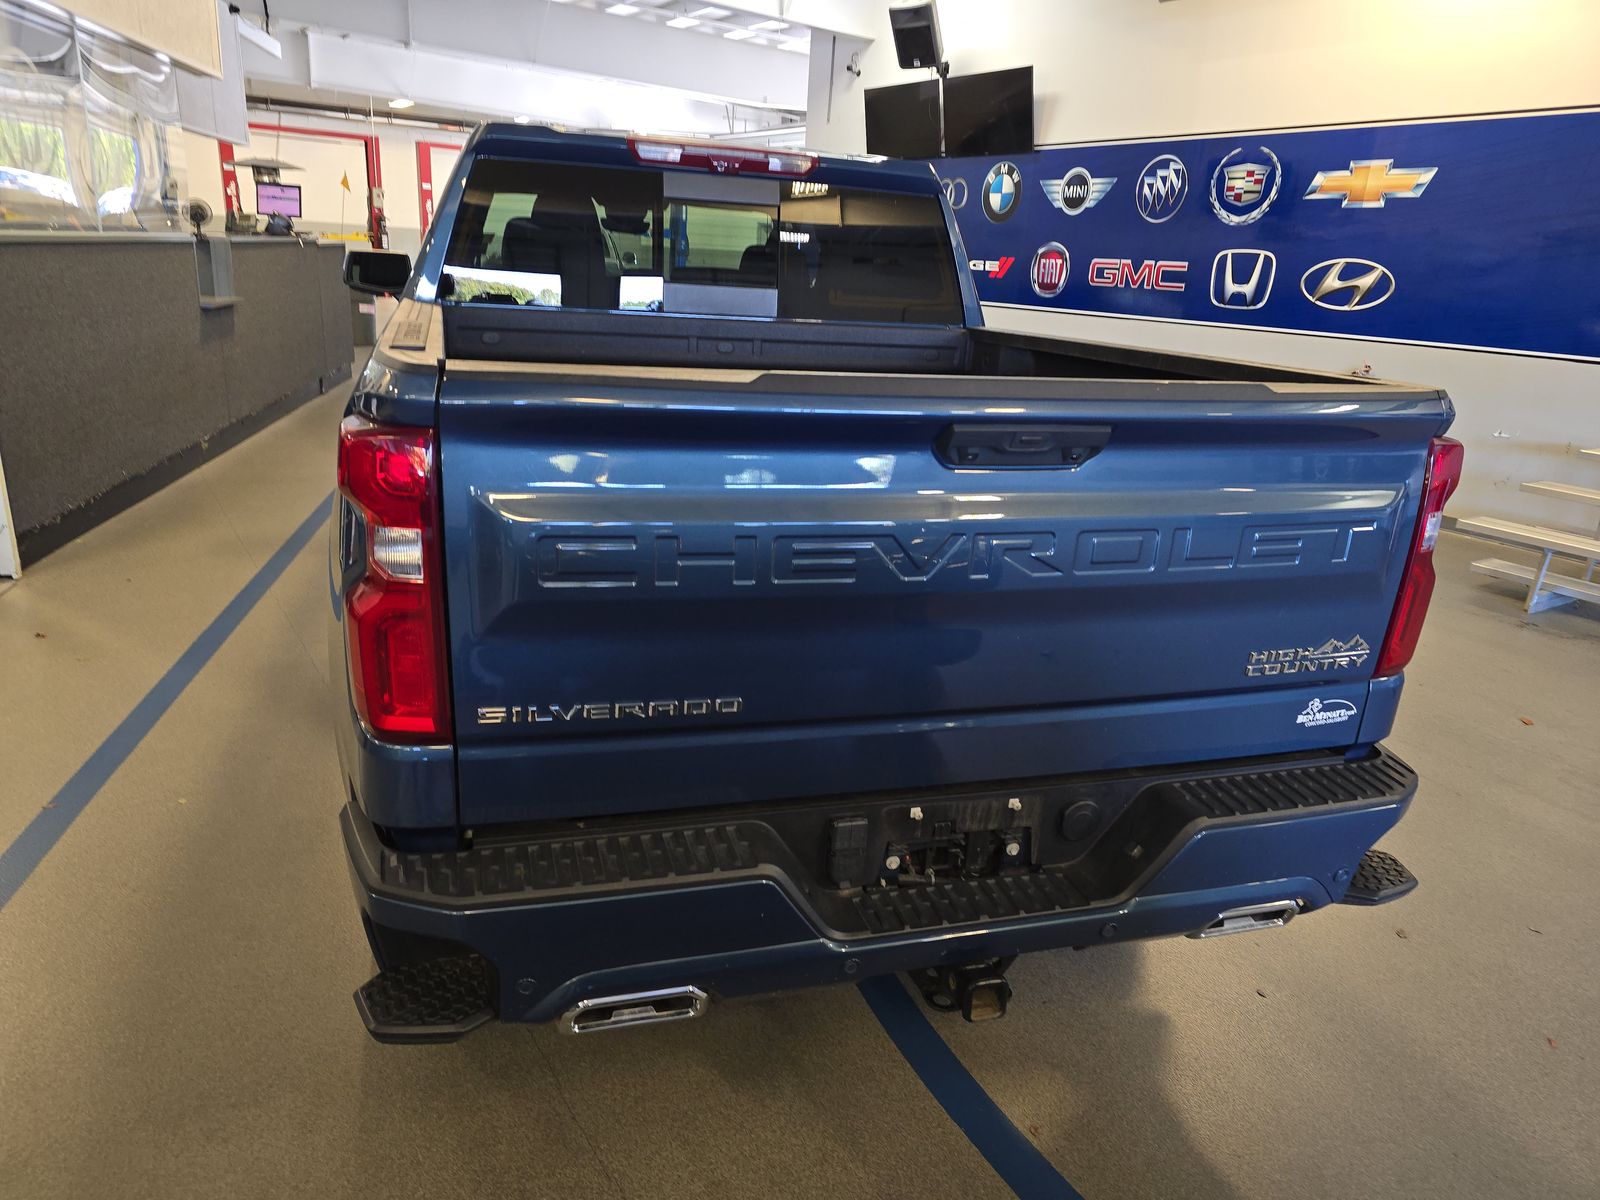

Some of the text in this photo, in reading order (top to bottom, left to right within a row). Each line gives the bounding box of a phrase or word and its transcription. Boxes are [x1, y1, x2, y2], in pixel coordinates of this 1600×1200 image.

[988, 163, 1020, 183] BMW
[1063, 185, 1088, 198] MINI
[1039, 258, 1062, 284] FIAT
[1088, 257, 1189, 292] GMC
[536, 520, 1378, 588] CHEVROLET
[1245, 655, 1368, 677] COUNTRY
[1250, 647, 1314, 663] HIGH
[477, 697, 744, 725] SILVERADO
